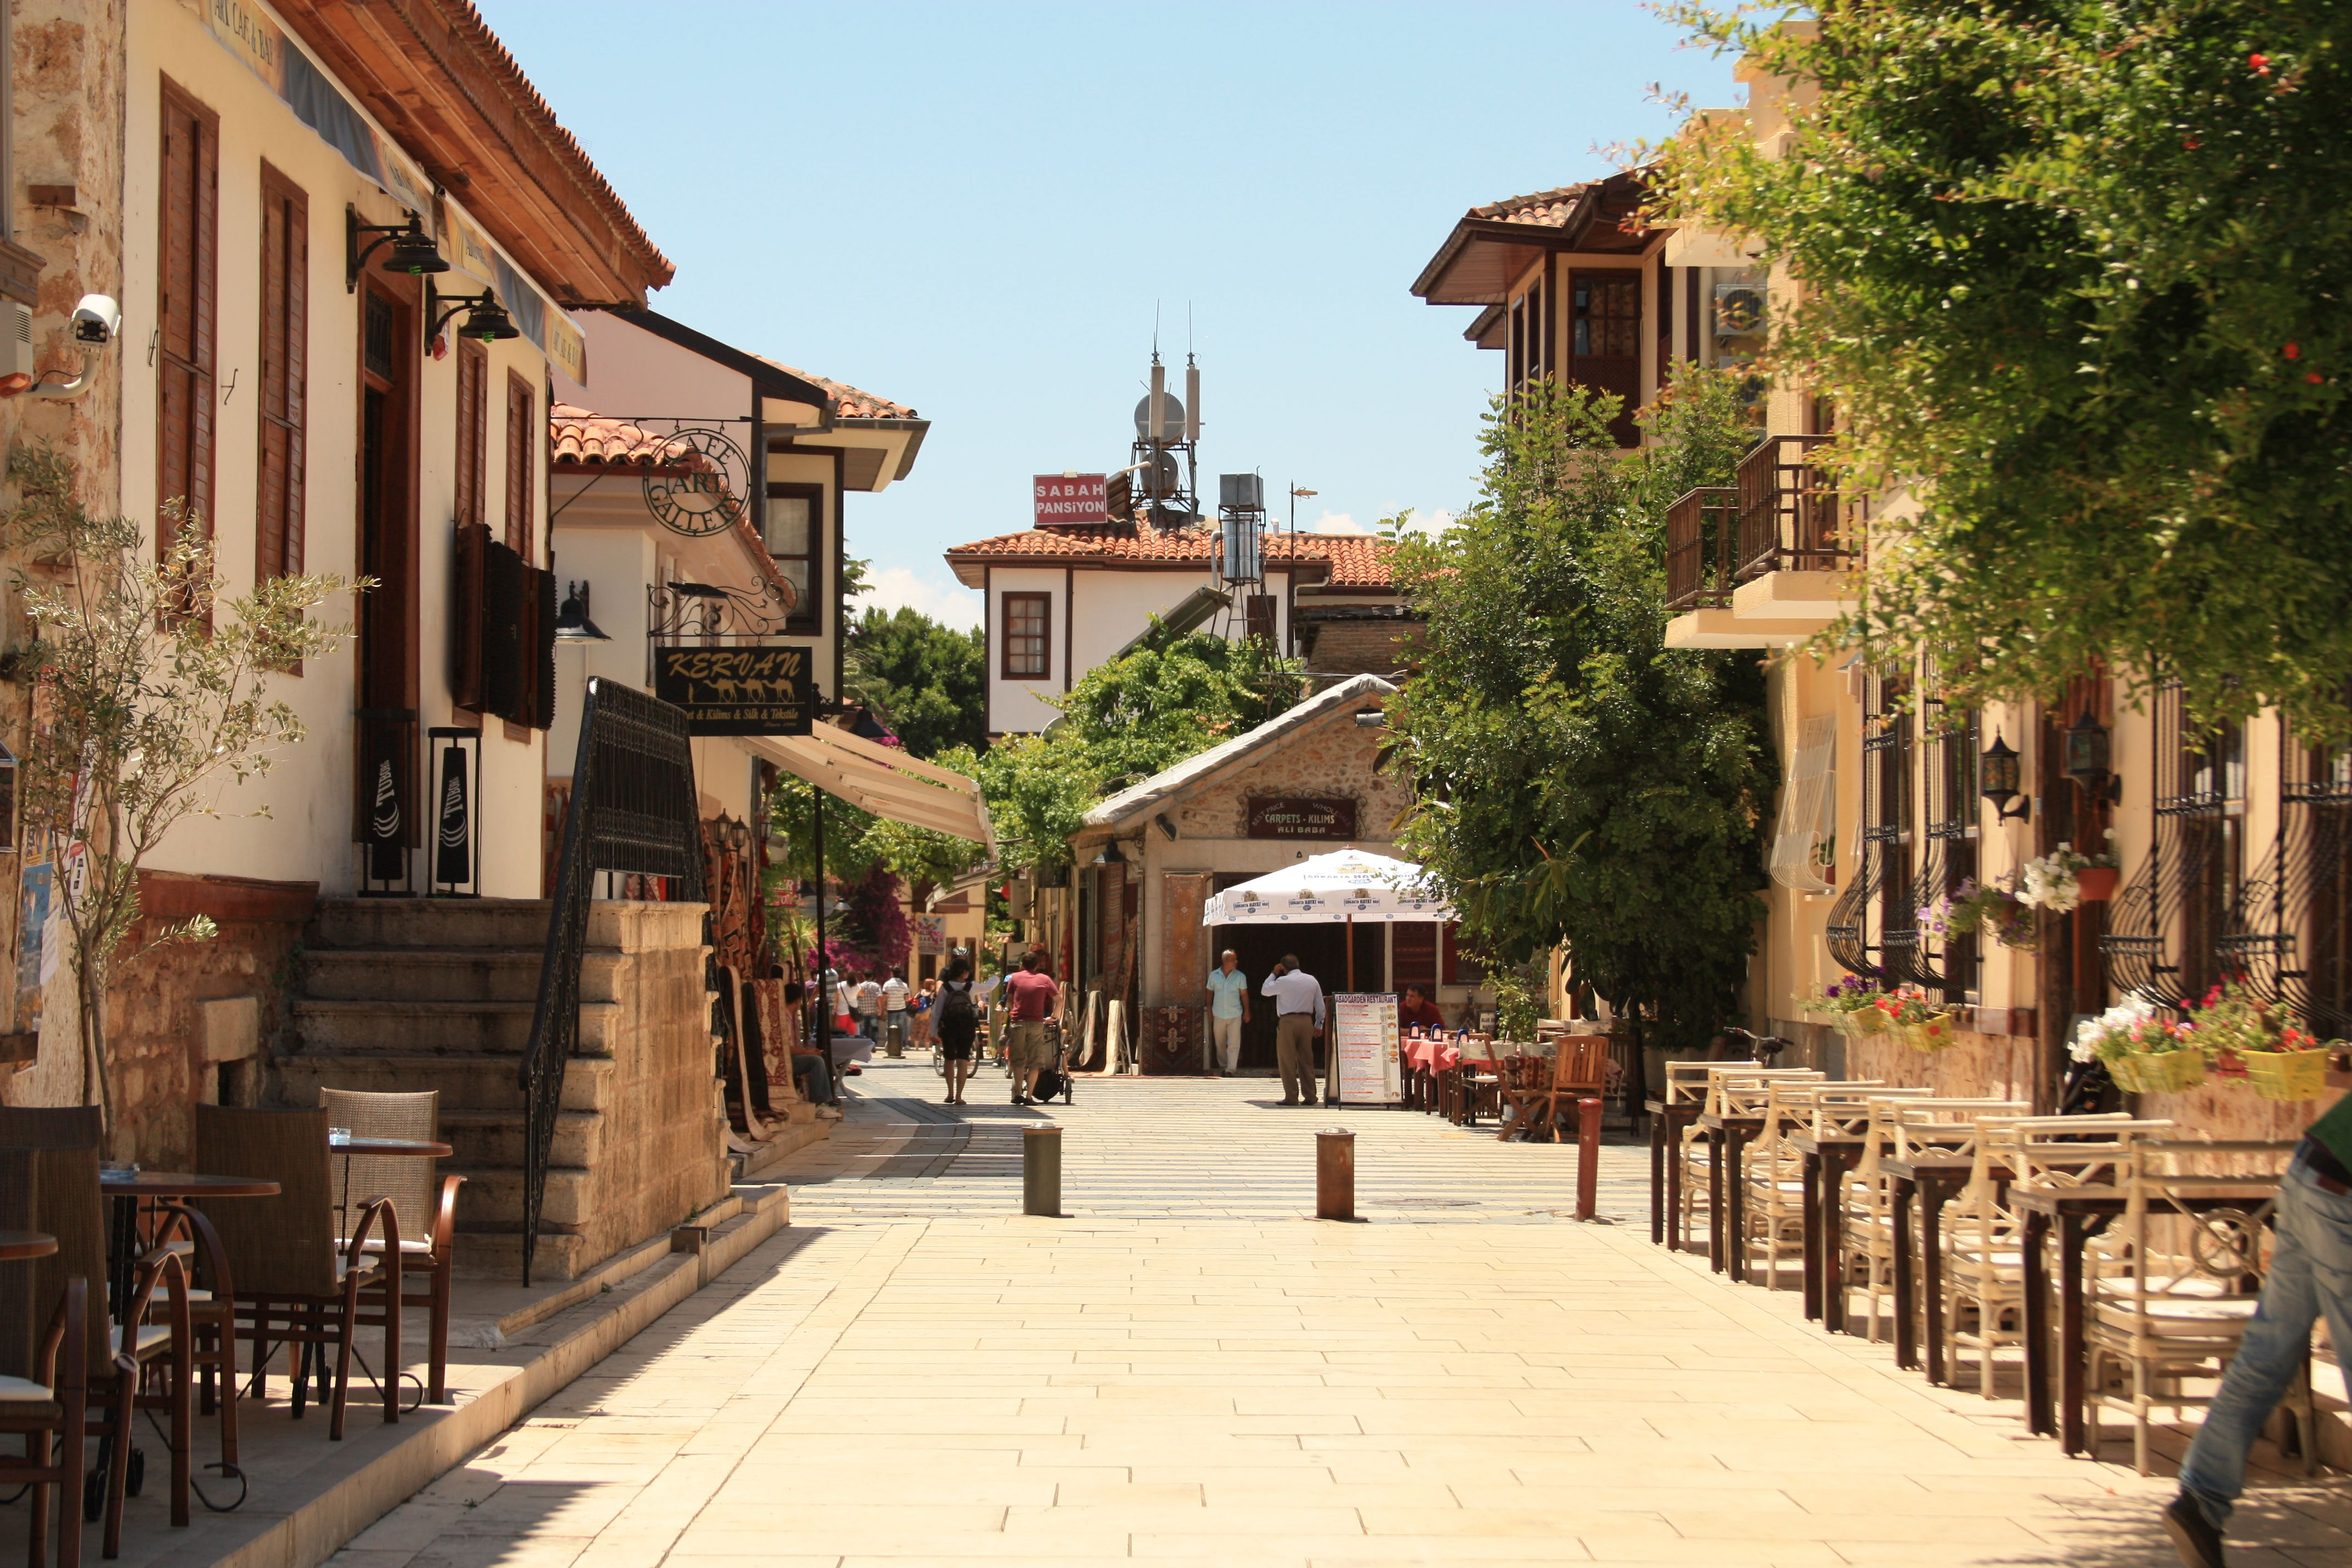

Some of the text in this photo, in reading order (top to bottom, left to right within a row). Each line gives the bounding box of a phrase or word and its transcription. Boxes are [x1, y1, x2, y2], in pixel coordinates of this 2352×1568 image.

[252, 22, 257, 53] &
[664, 434, 736, 465] CAFE
[671, 472, 727, 494] ART
[1037, 484, 1103, 497] SABAH
[650, 484, 744, 531] GALLERY
[667, 652, 801, 678] KERVAN
[696, 709, 704, 720] &
[706, 709, 731, 720] Kilims
[733, 709, 741, 720] &
[743, 708, 758, 720] Silk
[761, 709, 768, 720] &
[771, 708, 798, 720] Tekstile
[375, 759, 395, 807] TUBORG
[443, 776, 463, 819] TUBORG
[1251, 802, 1285, 826] BEST PRICE
[1265, 814, 1300, 824] CARPETS
[1308, 814, 1335, 824] KILIMS
